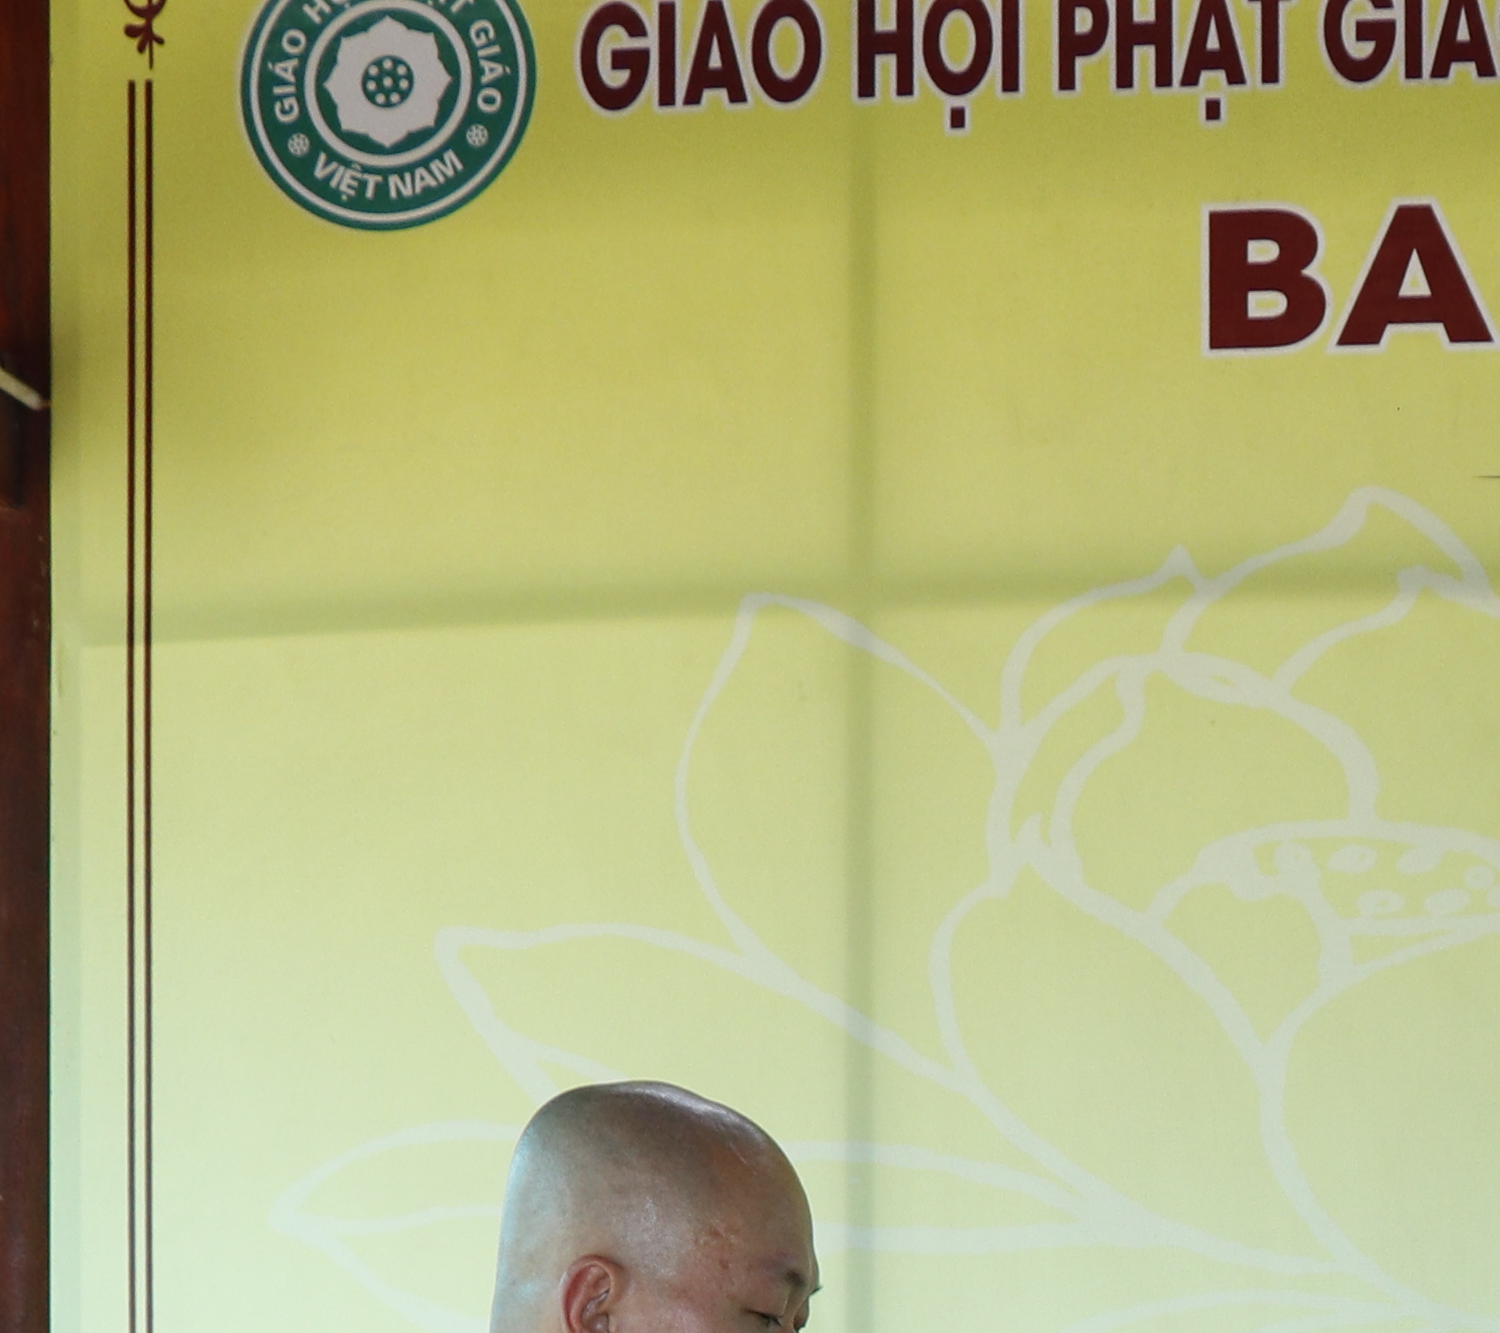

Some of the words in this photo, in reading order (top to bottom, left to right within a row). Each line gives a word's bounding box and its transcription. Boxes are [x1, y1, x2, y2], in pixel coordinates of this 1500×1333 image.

[267, 28, 307, 124] GIÁO
[468, 18, 512, 114] GIÁO
[312, 151, 383, 202] VIỆT
[387, 149, 464, 199] NAM
